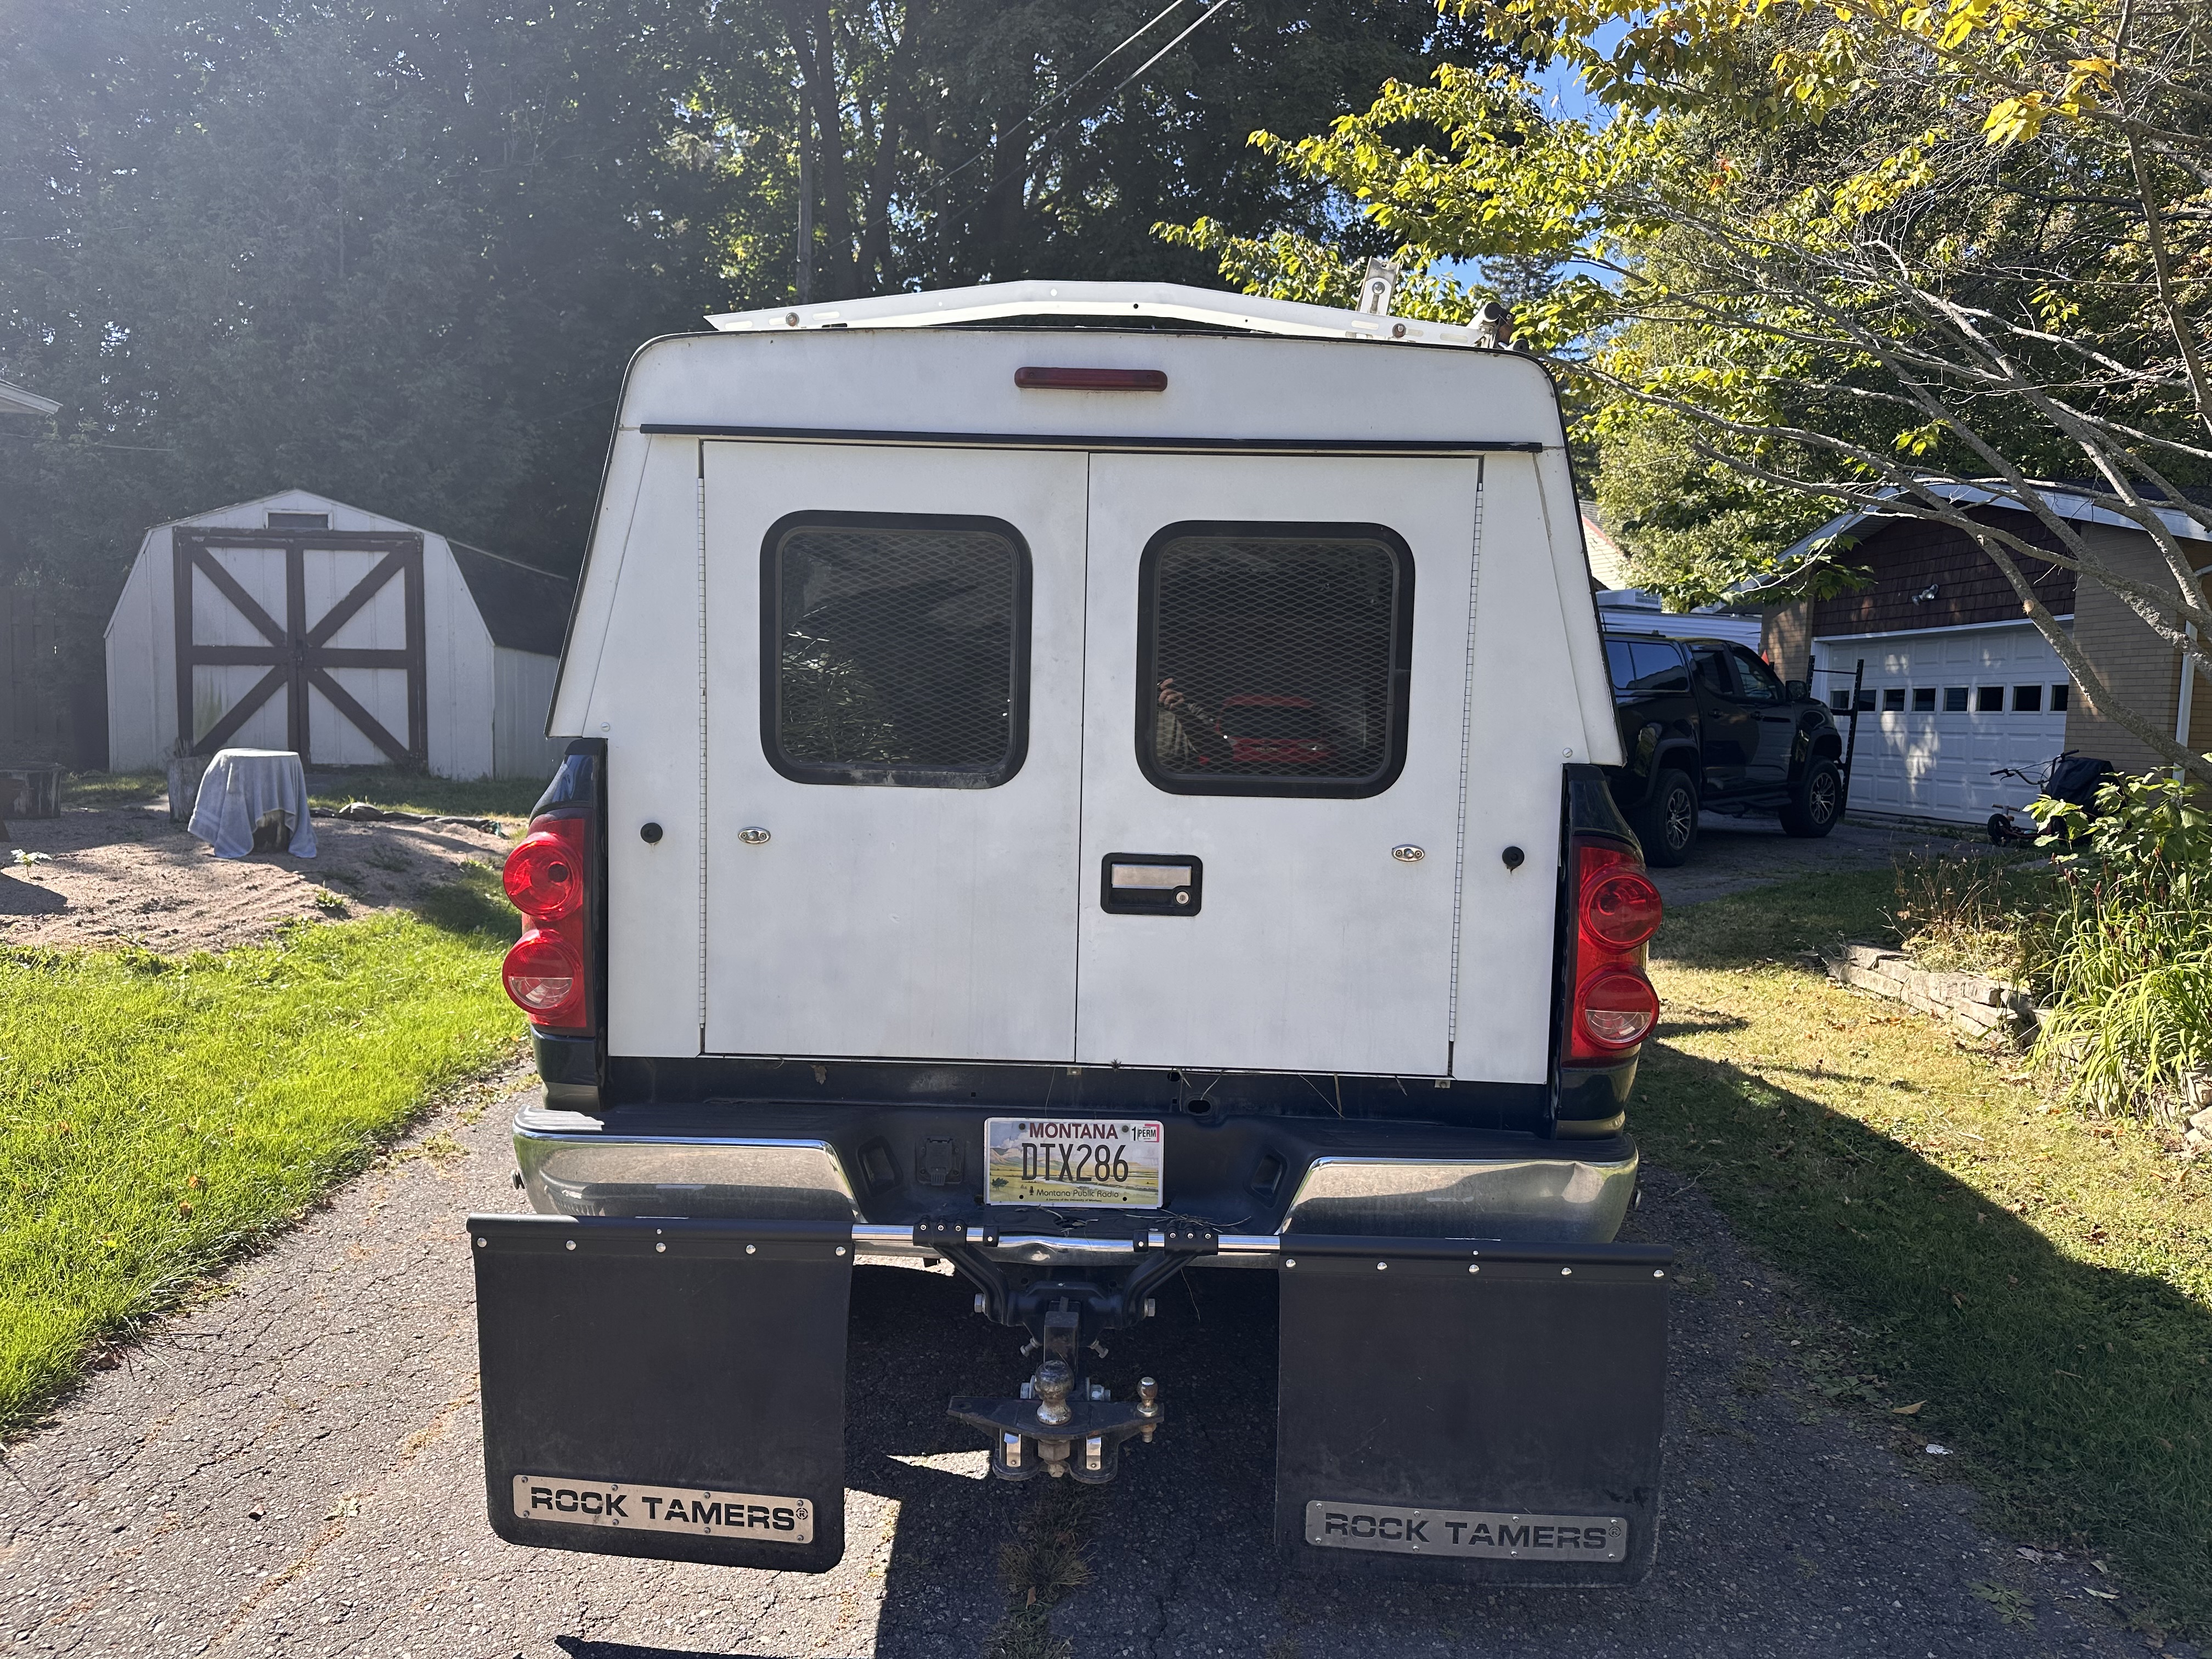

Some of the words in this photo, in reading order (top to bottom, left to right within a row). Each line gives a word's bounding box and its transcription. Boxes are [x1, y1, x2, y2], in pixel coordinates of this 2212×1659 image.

[1029, 1122, 1119, 1139] MONTANA
[1132, 1126, 1136, 1141] 1
[1138, 1129, 1156, 1137] PERM
[1022, 1143, 1128, 1182] DTX286
[531, 1487, 629, 1517] ROCK
[1325, 1513, 1430, 1543] ROCK
